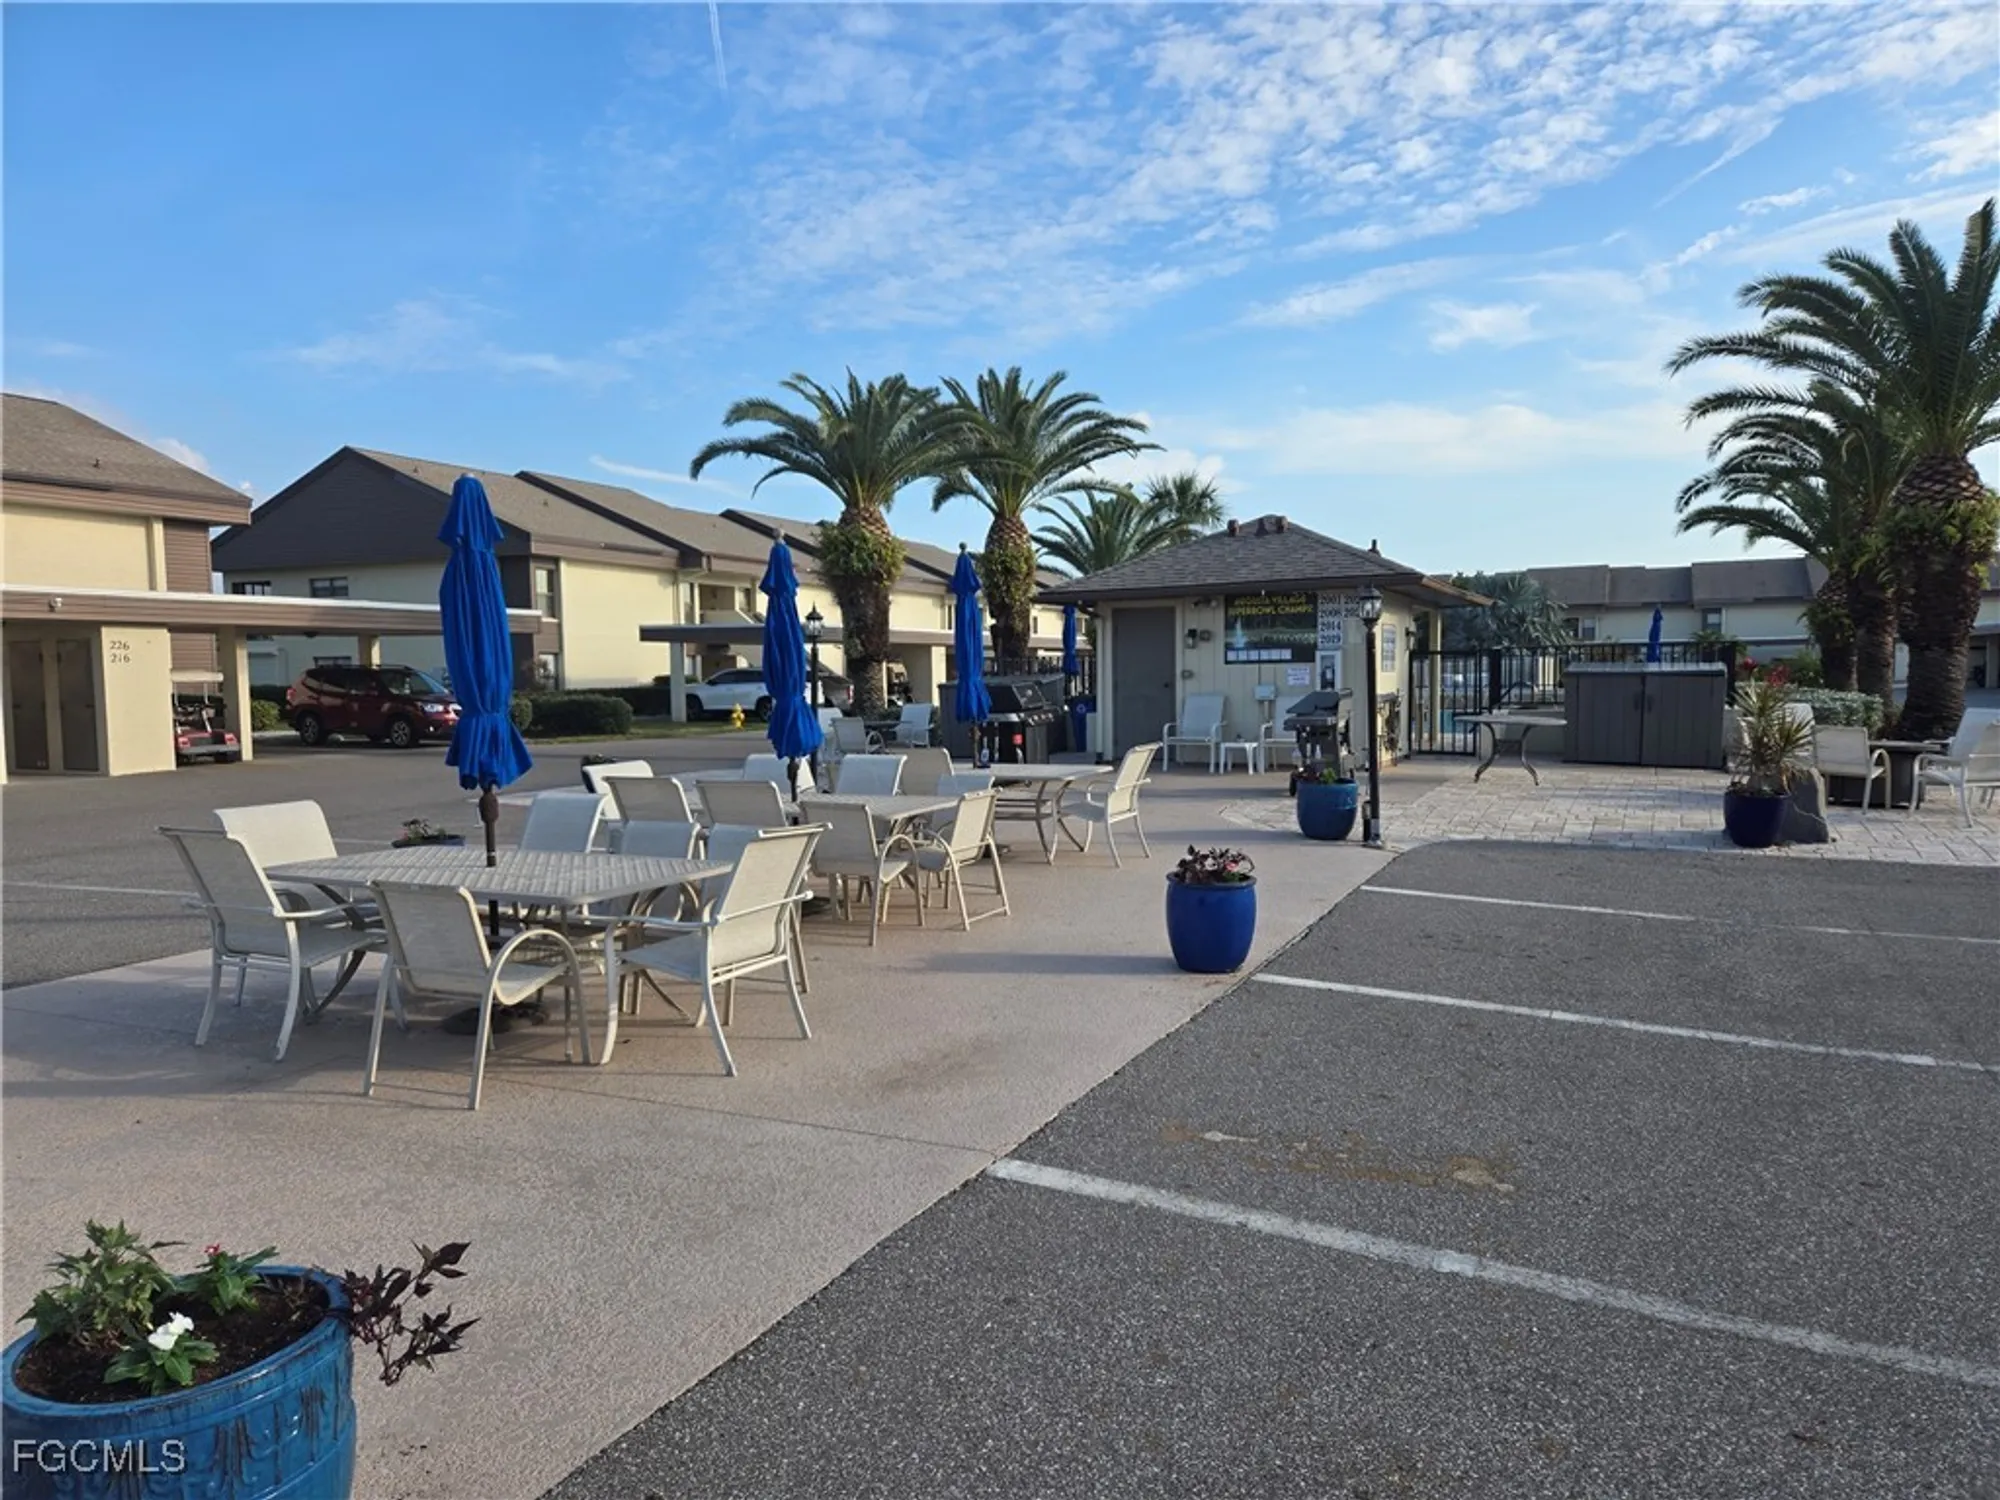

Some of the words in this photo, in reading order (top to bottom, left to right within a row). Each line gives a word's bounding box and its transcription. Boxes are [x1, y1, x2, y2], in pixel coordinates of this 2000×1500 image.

[1320, 620, 1341, 631] 2014
[110, 640, 130, 650] 226
[110, 653, 130, 663] 216
